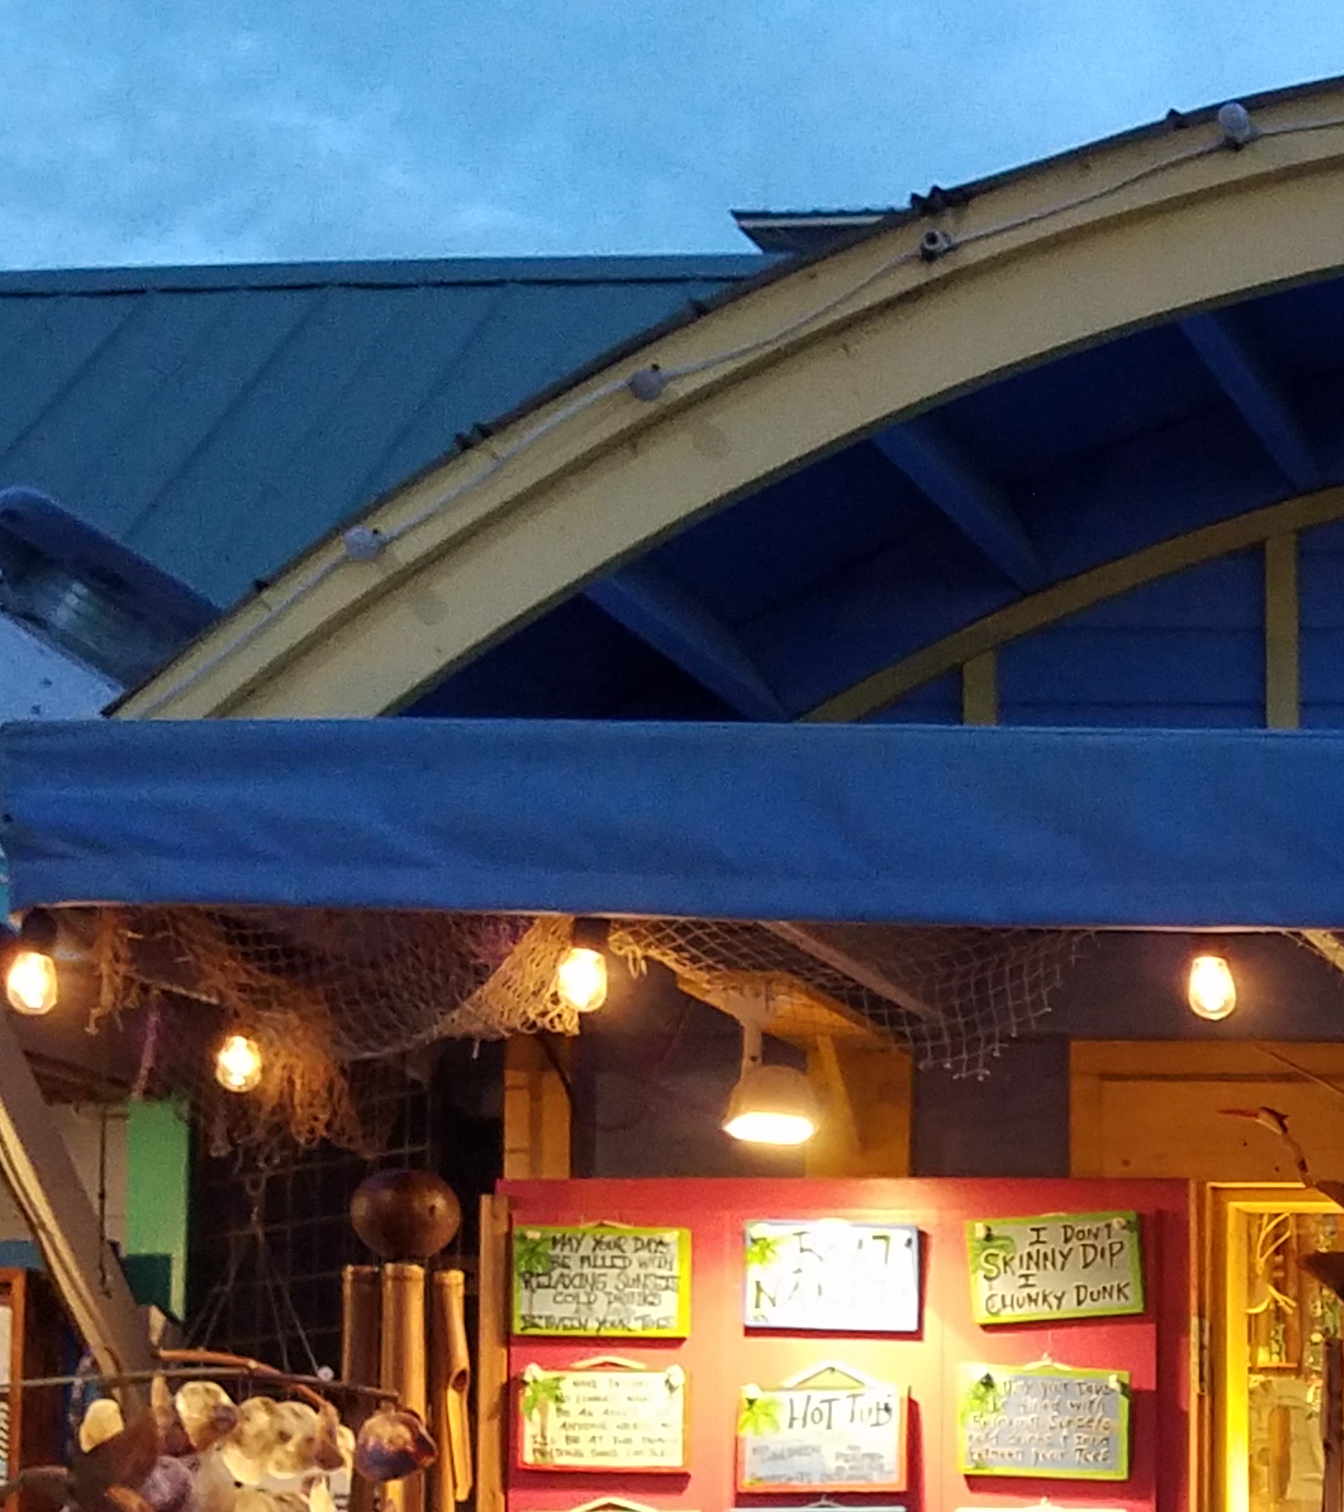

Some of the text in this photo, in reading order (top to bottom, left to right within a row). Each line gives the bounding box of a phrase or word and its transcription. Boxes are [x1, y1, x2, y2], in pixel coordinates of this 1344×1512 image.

[1029, 1227, 1047, 1246] I
[979, 1240, 1125, 1281] SKINNY DIP
[984, 1281, 1131, 1317] CHUNKY DUNK
[1017, 1273, 1037, 1289] I
[788, 1392, 893, 1430] HOT TUB
